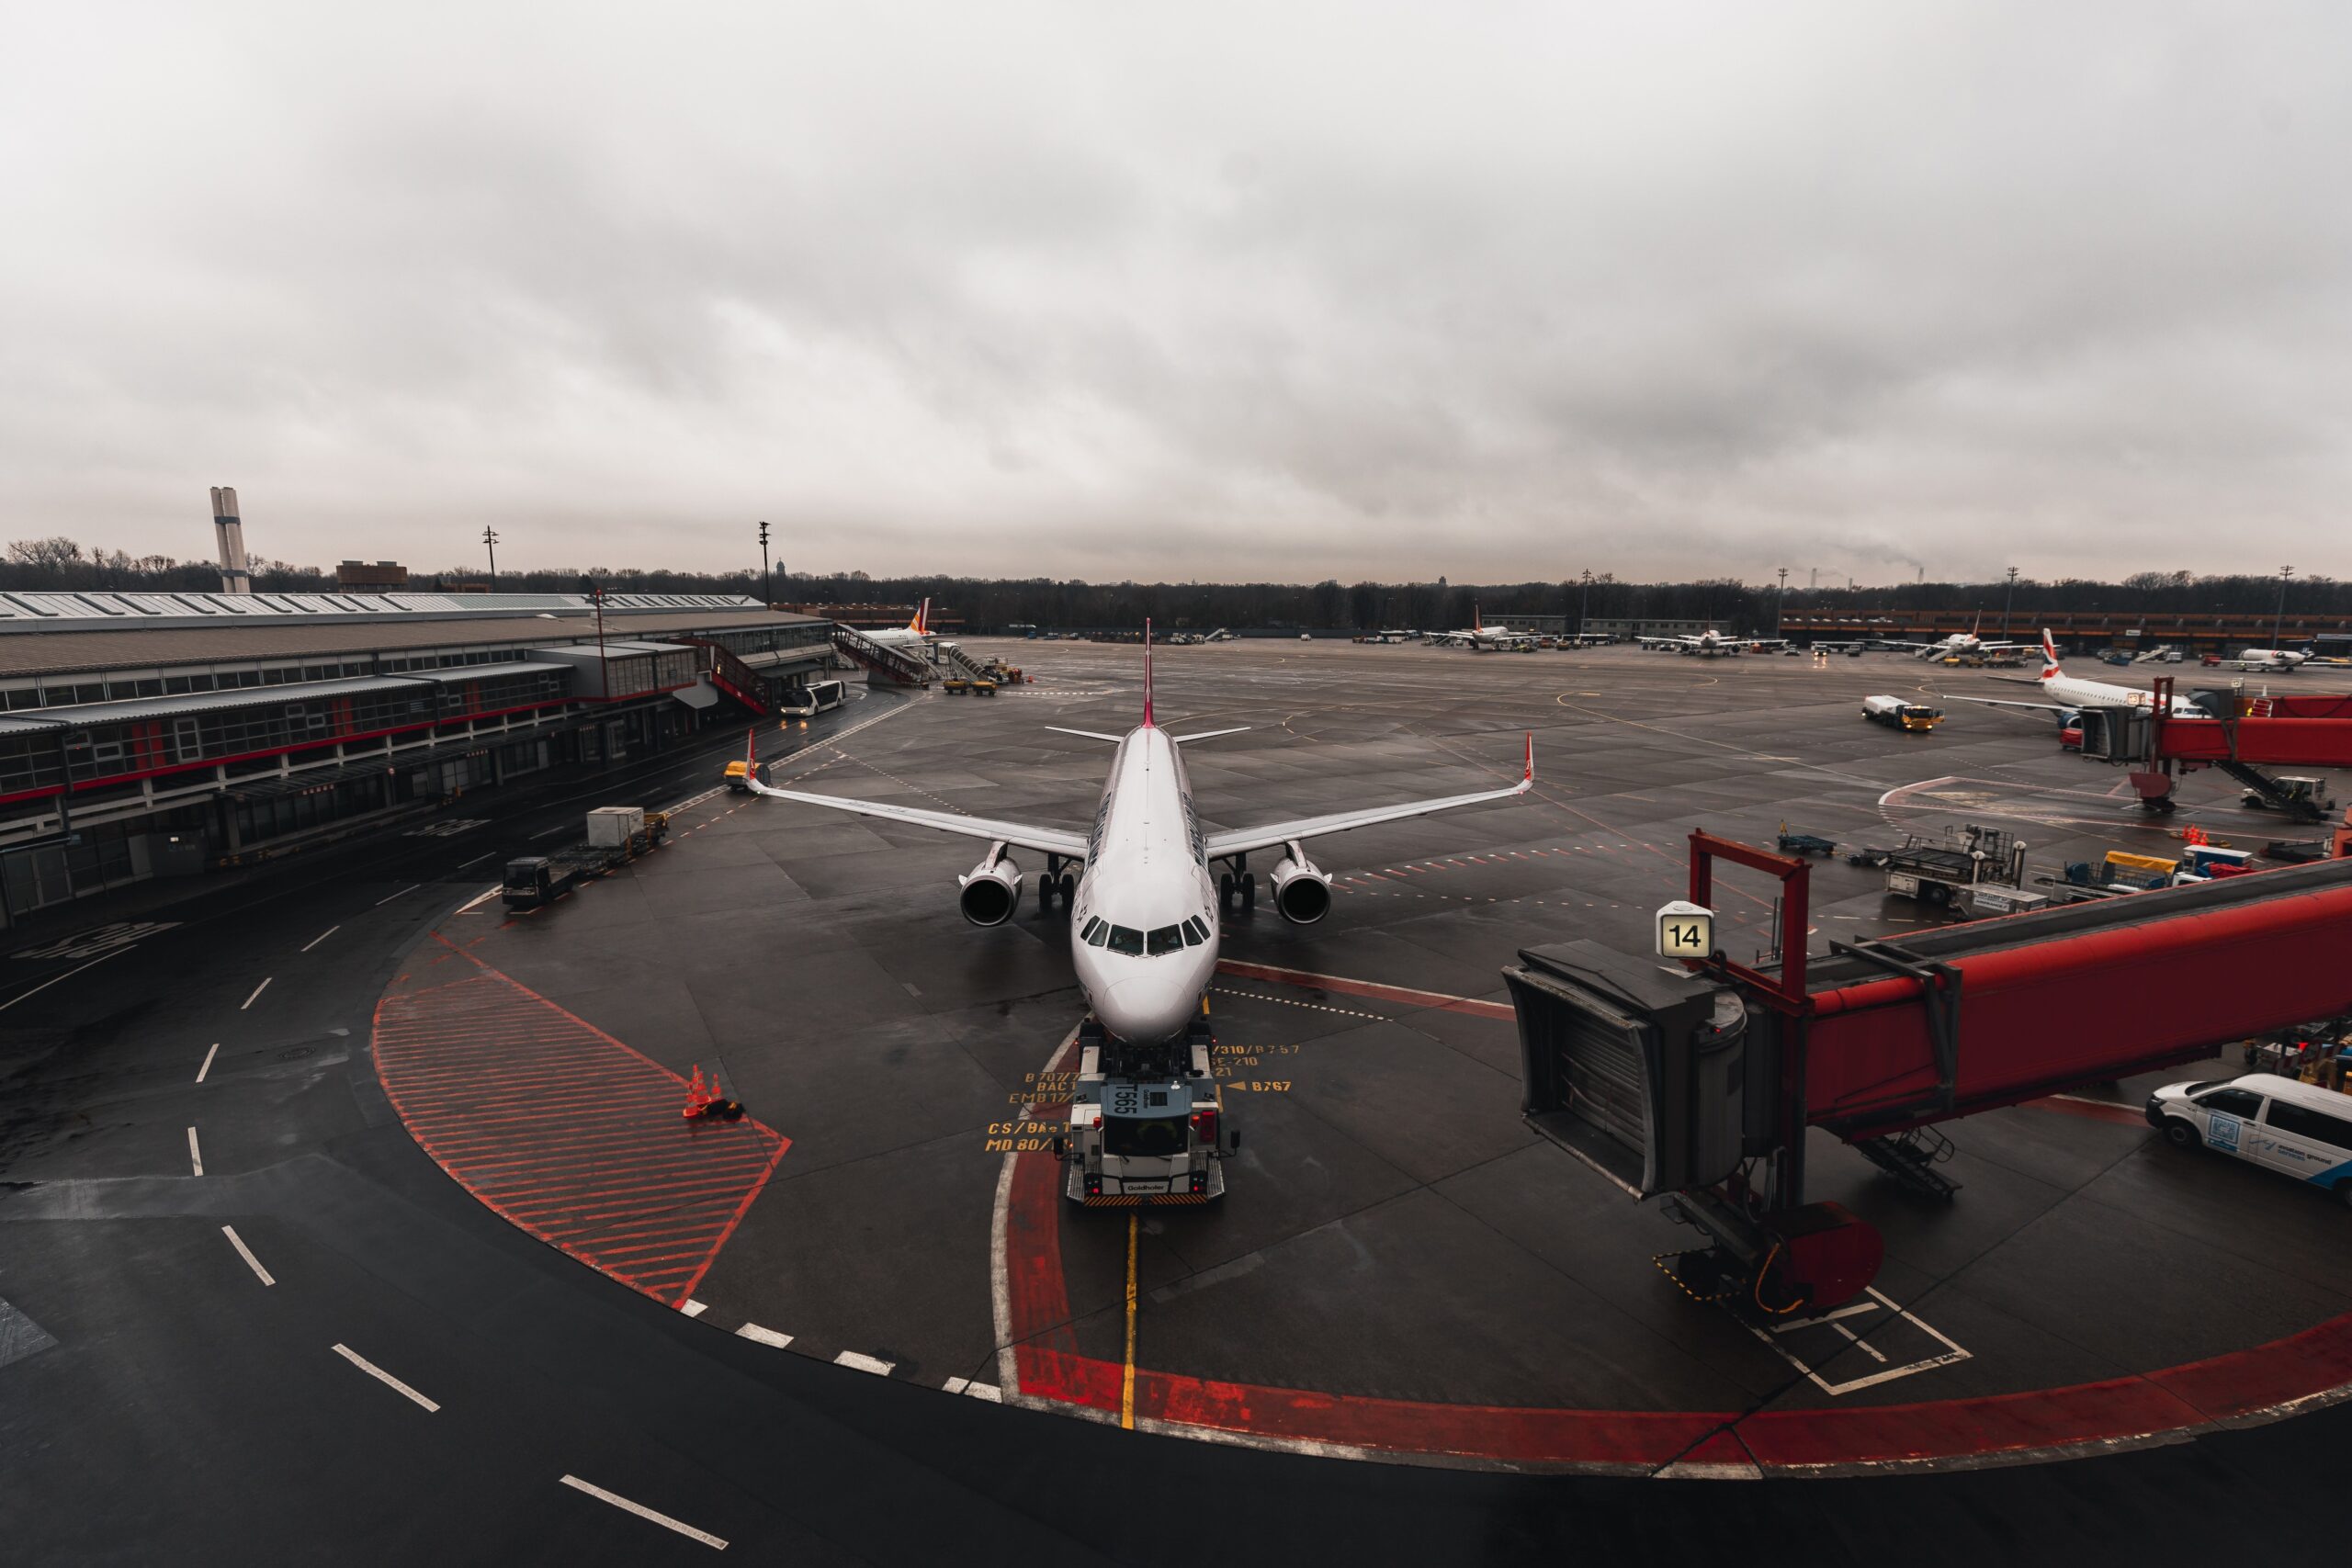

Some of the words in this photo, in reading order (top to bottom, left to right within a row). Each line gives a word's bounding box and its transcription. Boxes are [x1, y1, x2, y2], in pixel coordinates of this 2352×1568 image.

[1669, 925, 1701, 947] 14
[1036, 1081, 1068, 1091] BAC
[1251, 1081, 1292, 1092] B767
[1114, 1084, 1138, 1114] T565
[985, 1138, 1013, 1152] MD
[2278, 1145, 2305, 1156] aviation
[2306, 1154, 2332, 1165] ground
[2278, 1149, 2305, 1161] services
